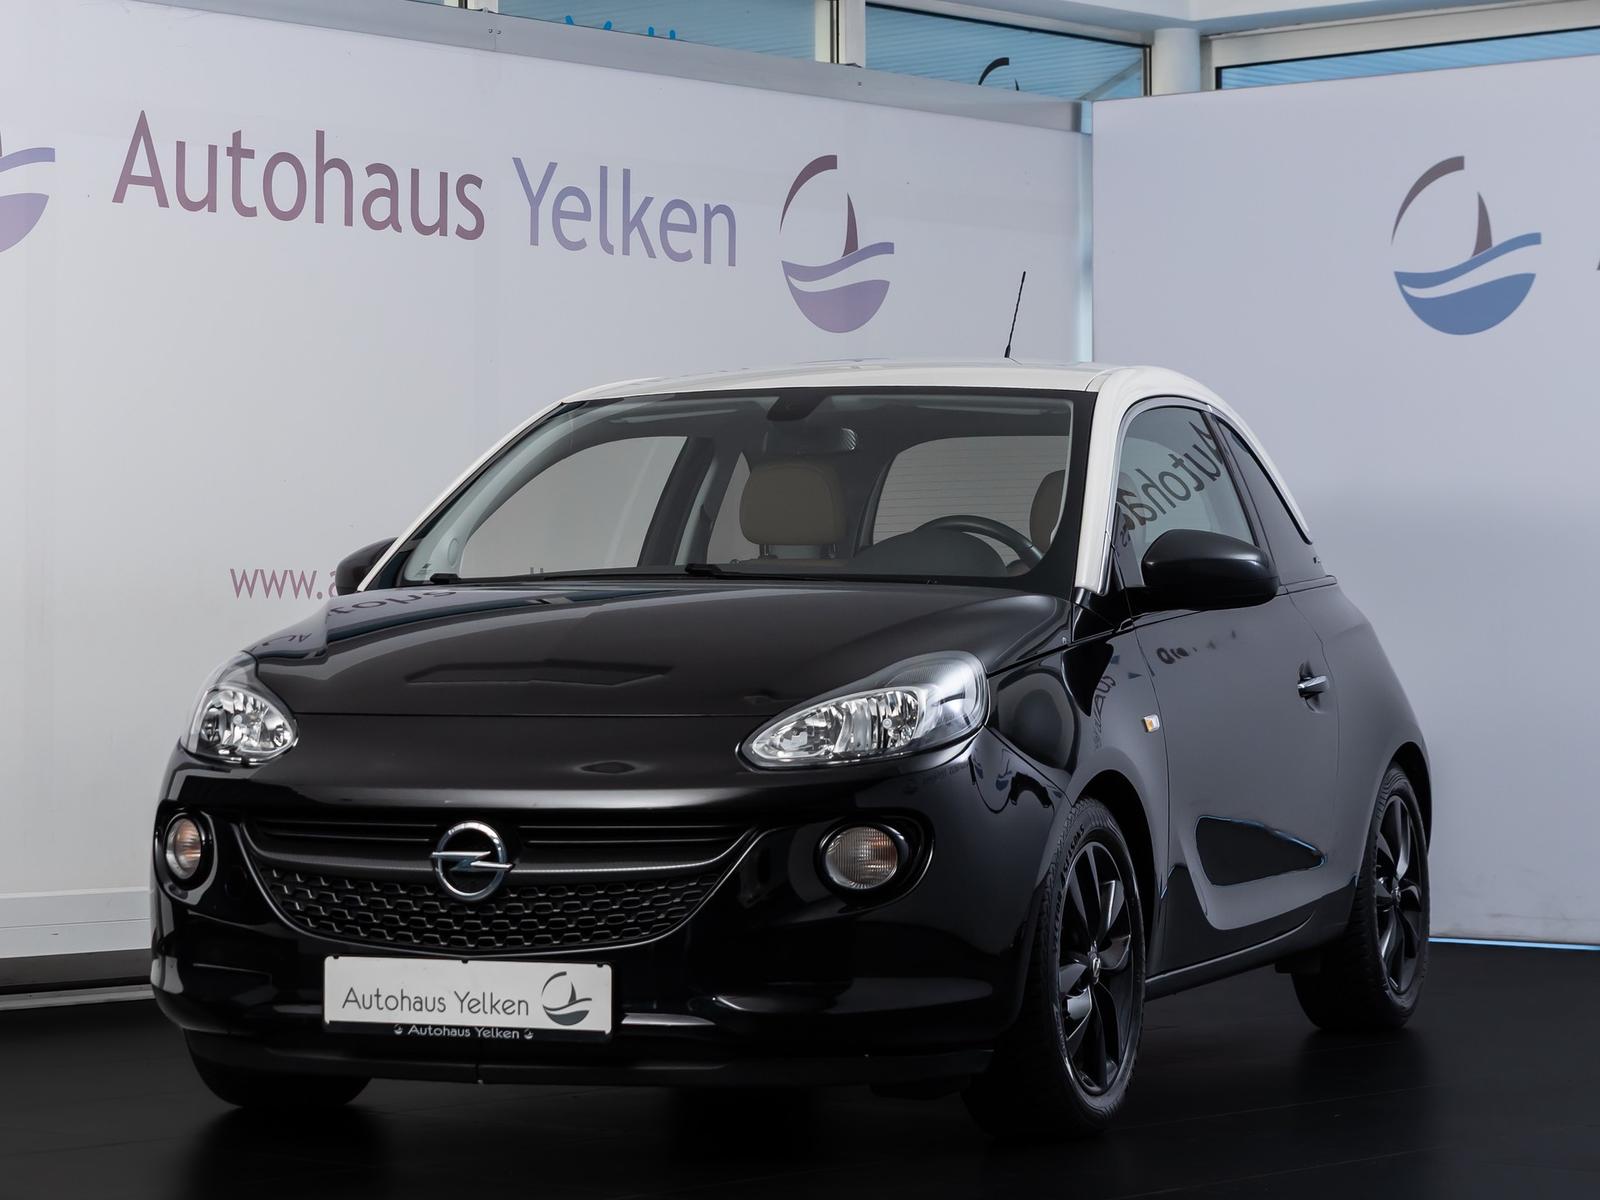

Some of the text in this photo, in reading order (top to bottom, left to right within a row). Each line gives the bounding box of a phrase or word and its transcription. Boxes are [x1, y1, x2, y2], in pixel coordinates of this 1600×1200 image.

[112, 110, 738, 267] Autohaus Yelken
[342, 986, 530, 1016] Autohaus Yelken
[407, 1024, 520, 1040] Autohaus Yelken
